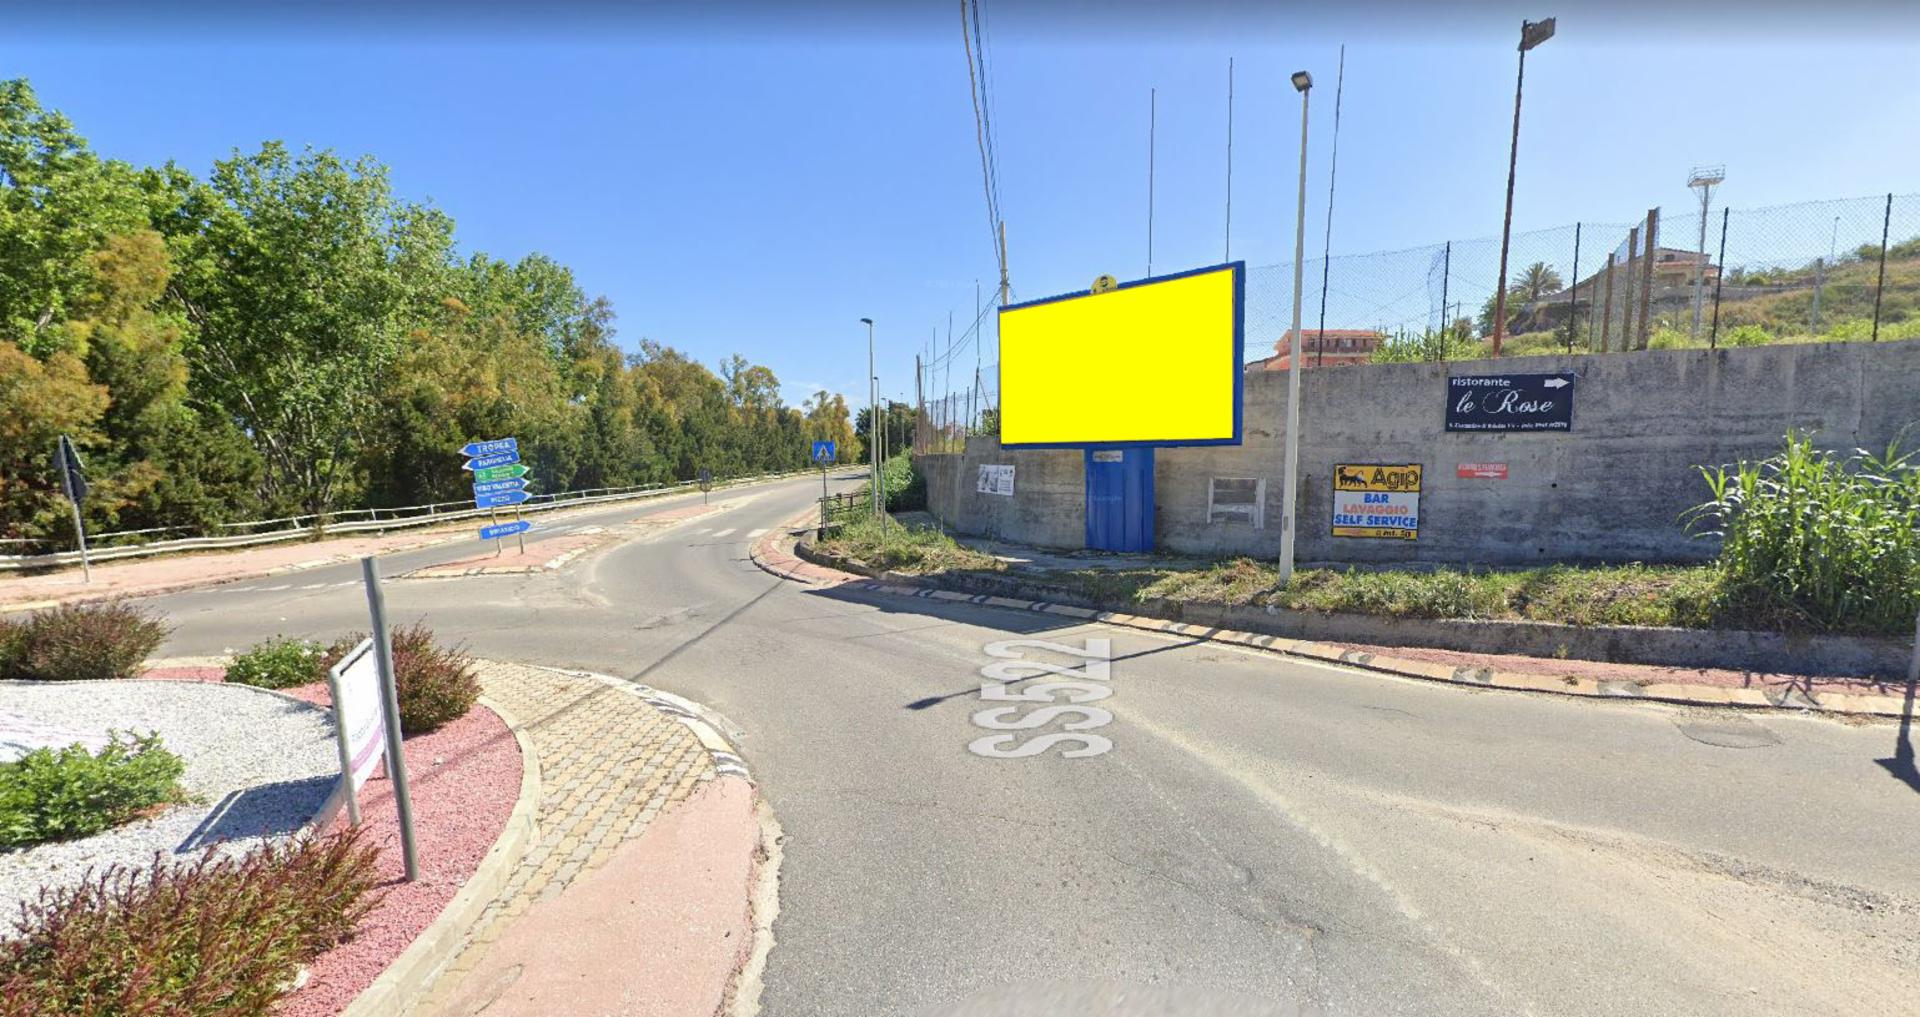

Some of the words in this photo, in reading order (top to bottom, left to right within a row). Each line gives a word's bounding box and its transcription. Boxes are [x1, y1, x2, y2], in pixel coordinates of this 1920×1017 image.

[1452, 377, 1511, 387] ristorante
[1456, 390, 1476, 413] le
[1482, 389, 1556, 414] Rose
[477, 441, 511, 453] TROPEA
[1370, 467, 1419, 490] Agip
[1364, 493, 1389, 504] BAR
[1343, 504, 1409, 515] LAVAGGIO
[1335, 514, 1363, 525] SELF
[1366, 515, 1417, 527] SERVICE
